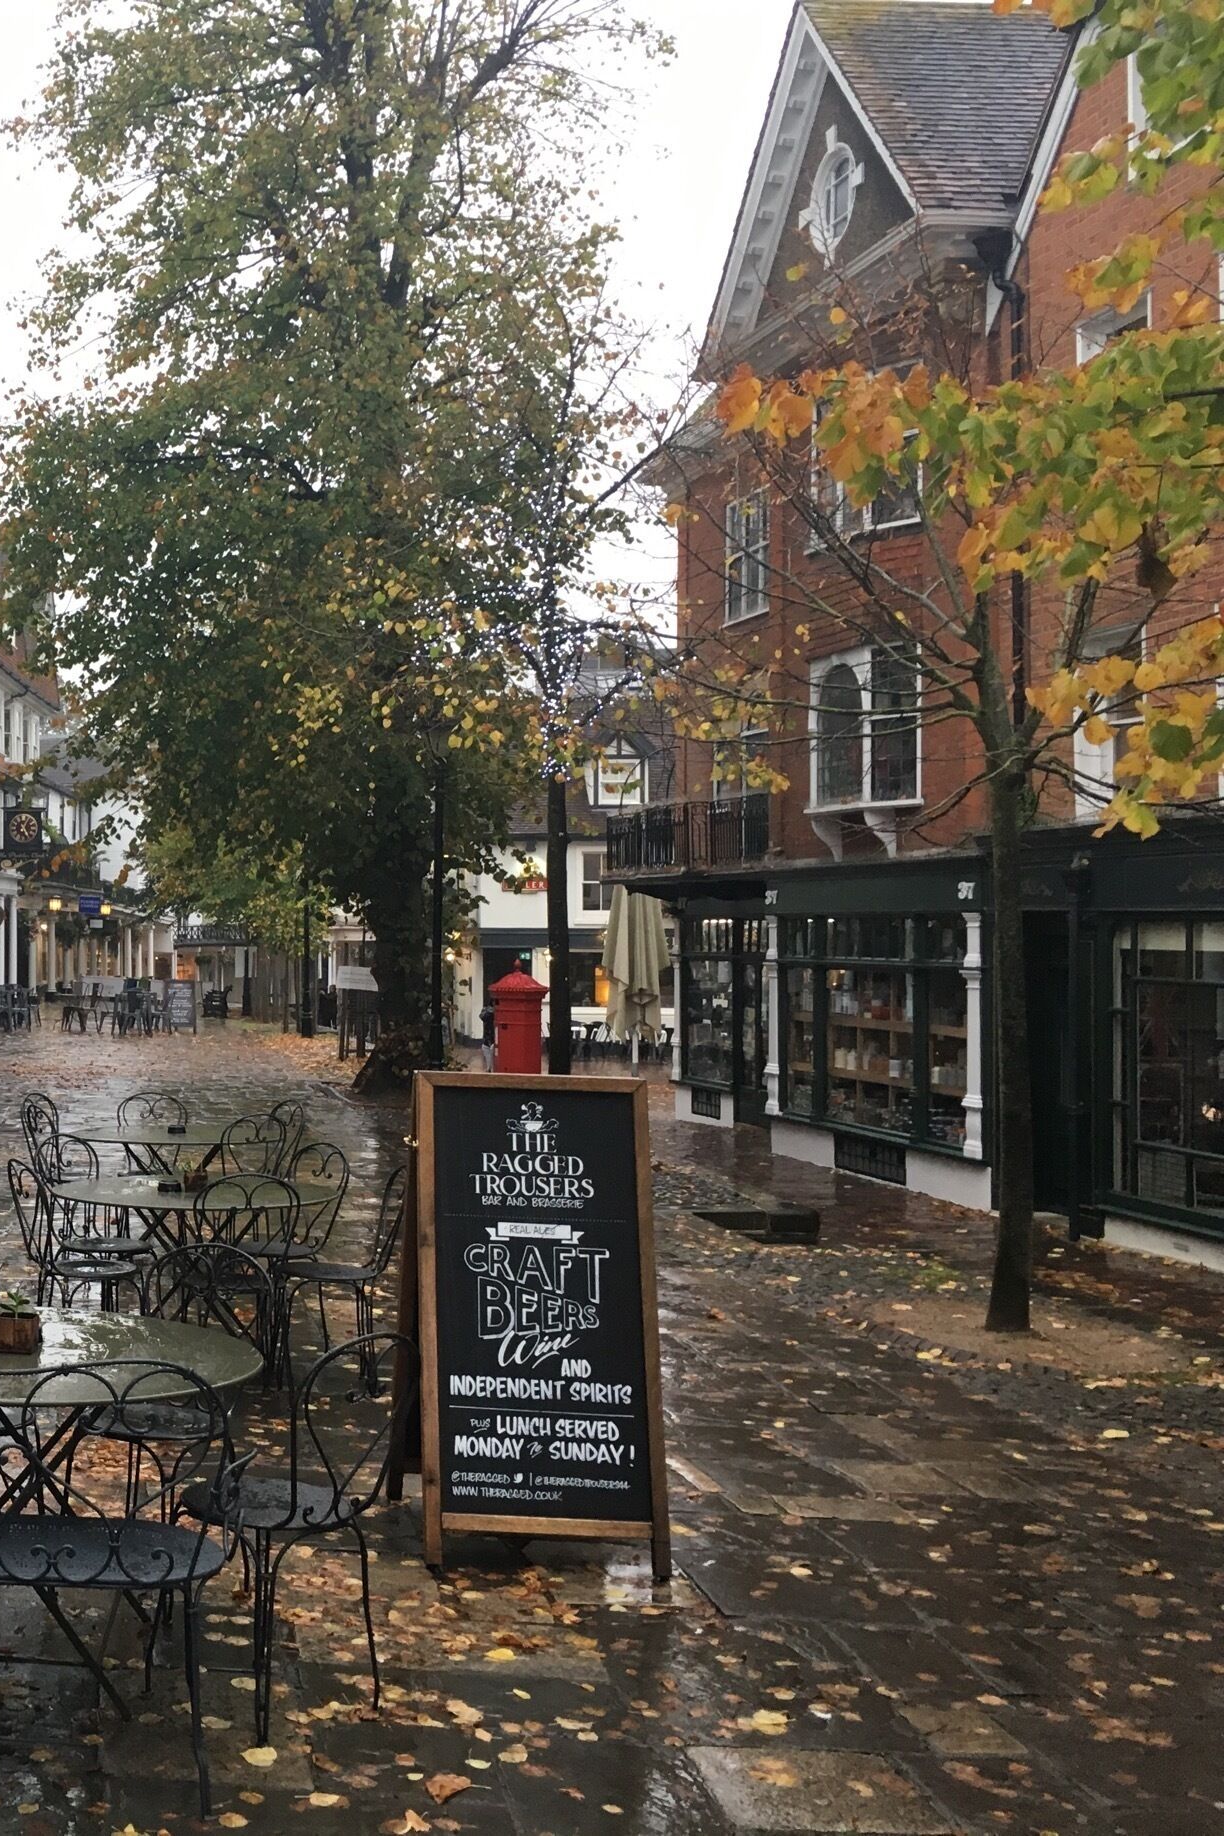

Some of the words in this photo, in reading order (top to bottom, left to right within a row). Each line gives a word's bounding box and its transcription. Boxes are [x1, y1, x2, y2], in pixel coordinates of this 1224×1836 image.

[765, 890, 778, 905] 37
[958, 881, 976, 899] 37
[506, 1132, 557, 1153] THE
[481, 1152, 584, 1176] RAGGED
[469, 1173, 595, 1198] TROUSERS
[481, 1195, 502, 1206] BAR
[506, 1196, 528, 1207] AND
[531, 1197, 585, 1209] BRASSERIE
[464, 1243, 610, 1304] CRAFT
[477, 1275, 600, 1340] BEERS
[560, 1358, 592, 1378] AND
[449, 1374, 566, 1401] INDEPENDENT
[569, 1382, 633, 1405] SPIRITS
[470, 1418, 491, 1429] PLUS
[496, 1414, 551, 1437] LUNCH
[555, 1418, 620, 1442] SERVED
[454, 1434, 524, 1460] MONDAY
[451, 1470, 511, 1484] @THERAGGED
